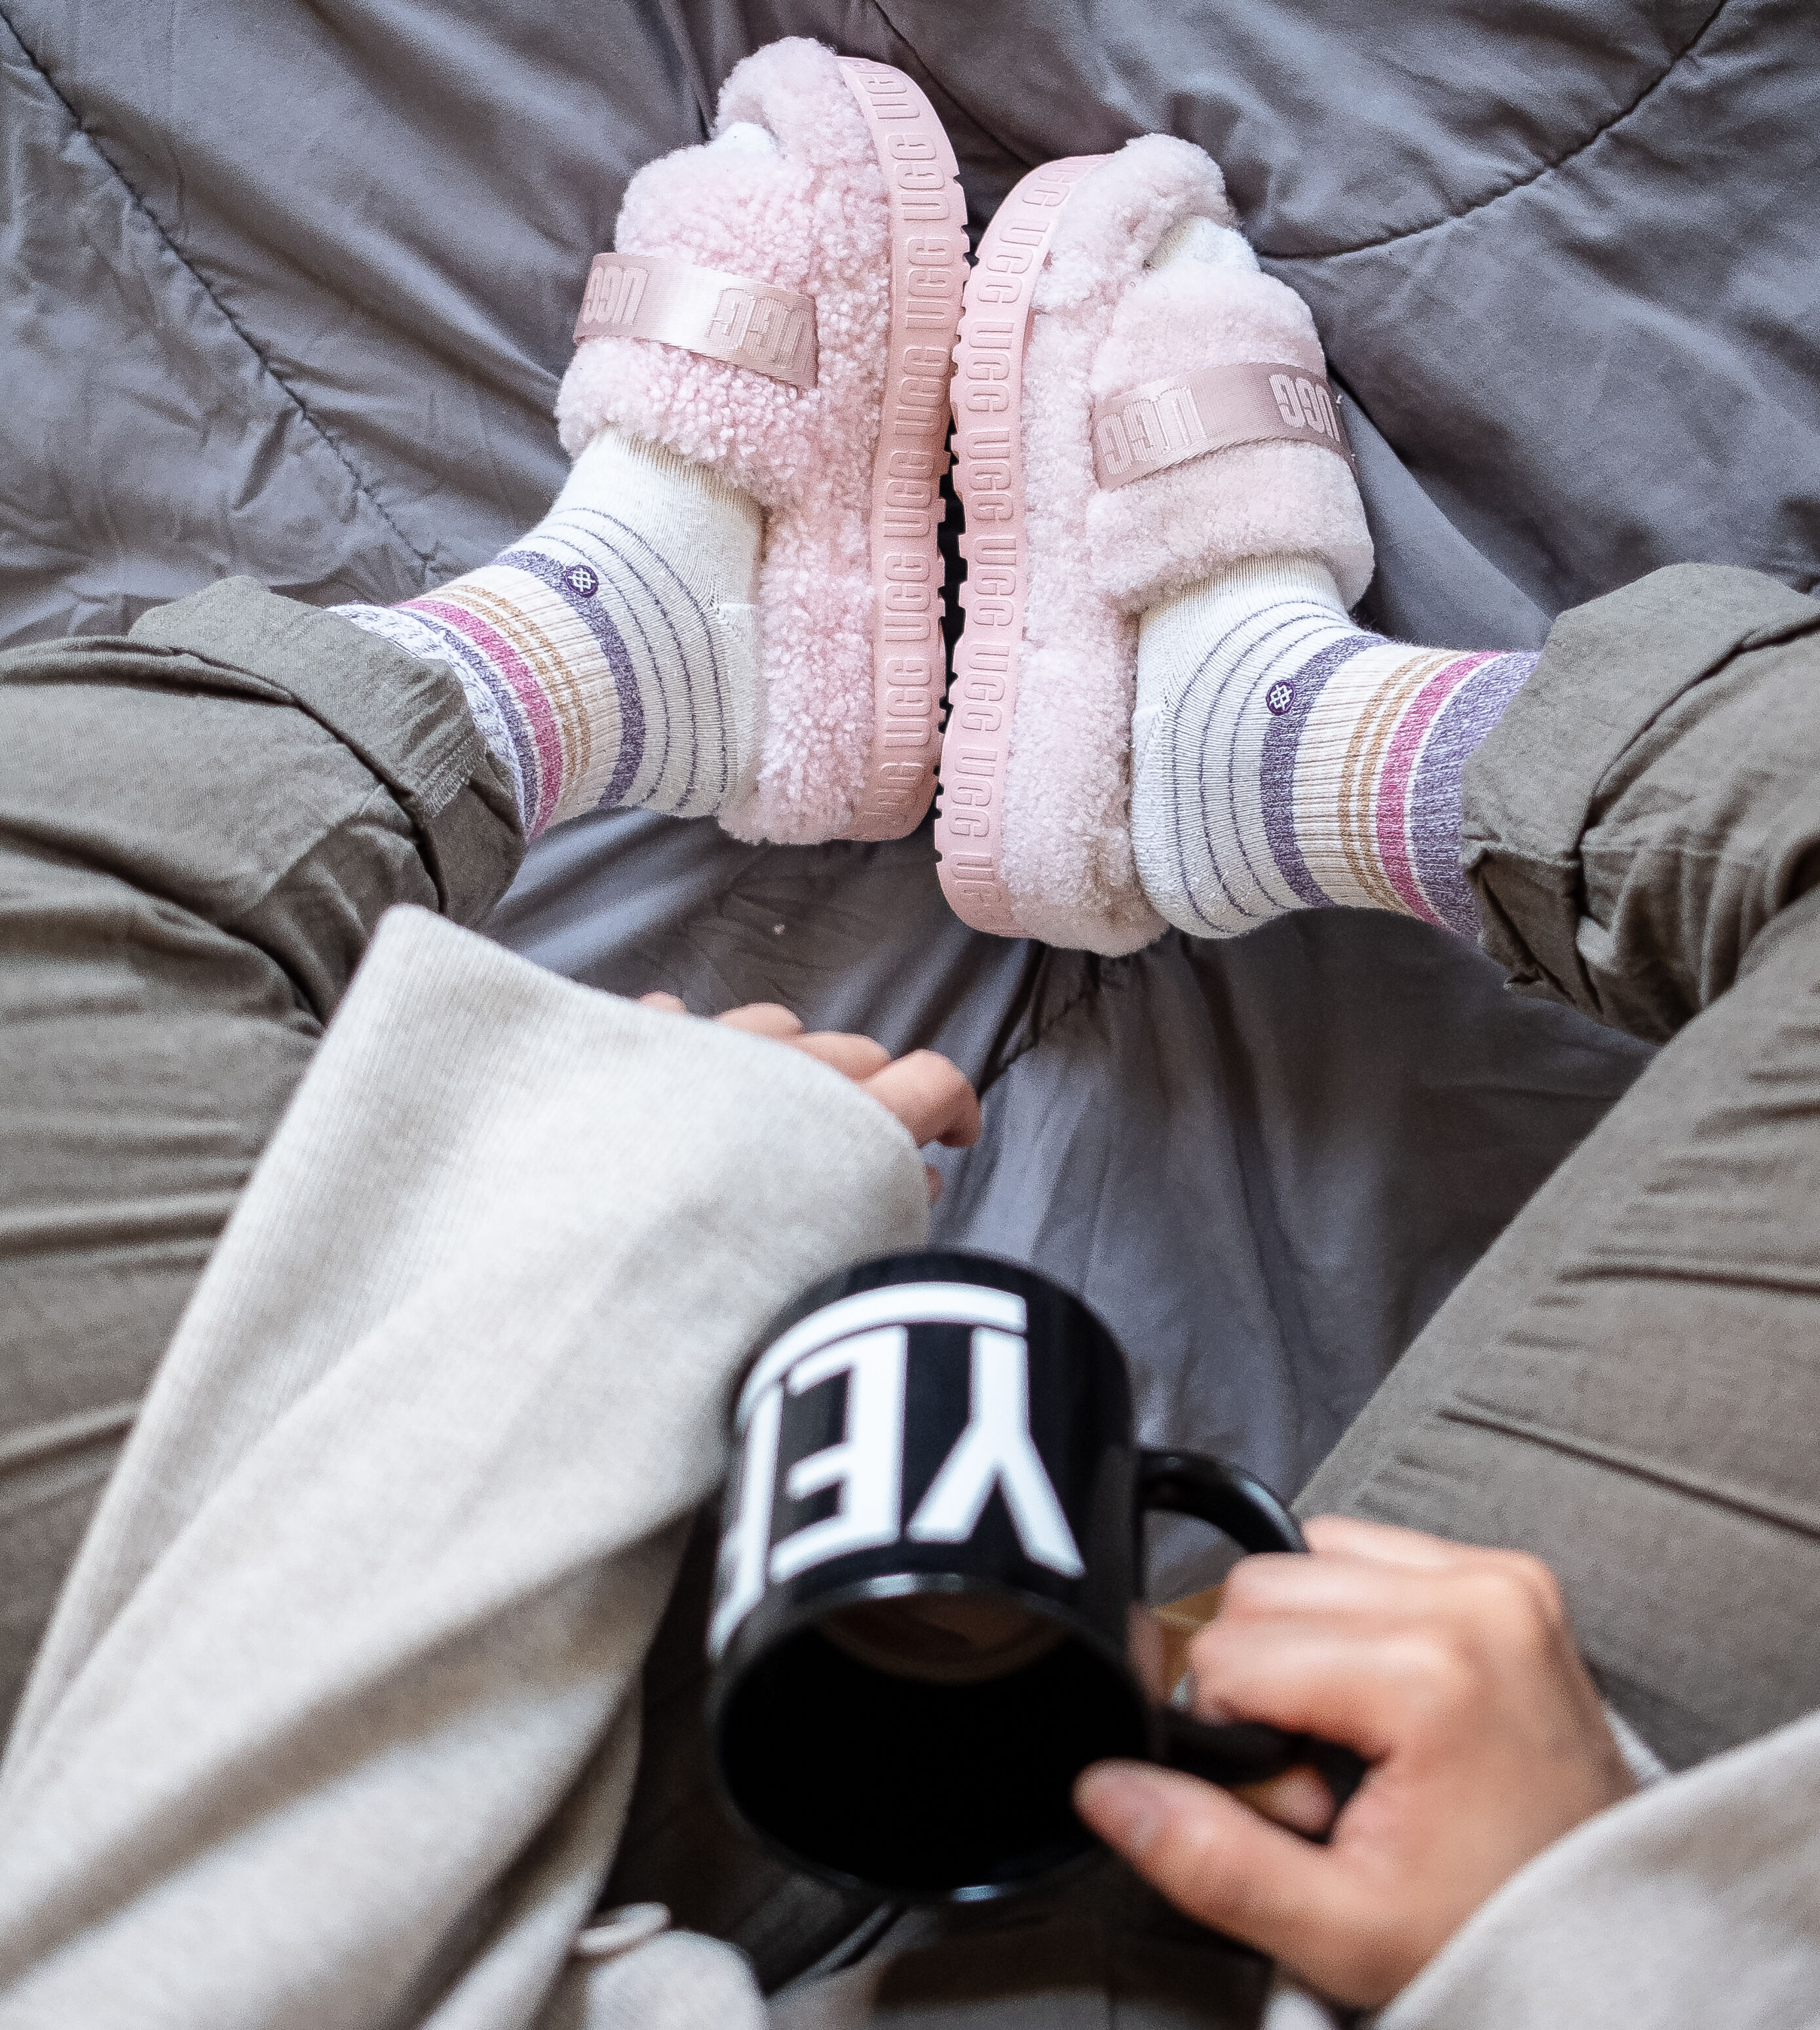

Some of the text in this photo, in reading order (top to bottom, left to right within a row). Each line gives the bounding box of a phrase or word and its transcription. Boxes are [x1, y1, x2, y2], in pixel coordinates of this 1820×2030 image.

[886, 134, 950, 221] UGG
[907, 238, 953, 329] UGG
[977, 219, 1049, 303] UGG
[708, 288, 812, 370] UGG
[965, 322, 1014, 412] UGG
[894, 348, 950, 436] UGG
[1095, 373, 1342, 475] UGG UGG
[884, 451, 934, 537] UGG
[967, 430, 1014, 520] UGG
[884, 555, 931, 642] UGG
[973, 537, 1017, 626] UGG
[884, 659, 932, 748] UGG
[960, 643, 1010, 732] UGG
[948, 747, 998, 838] UGG
